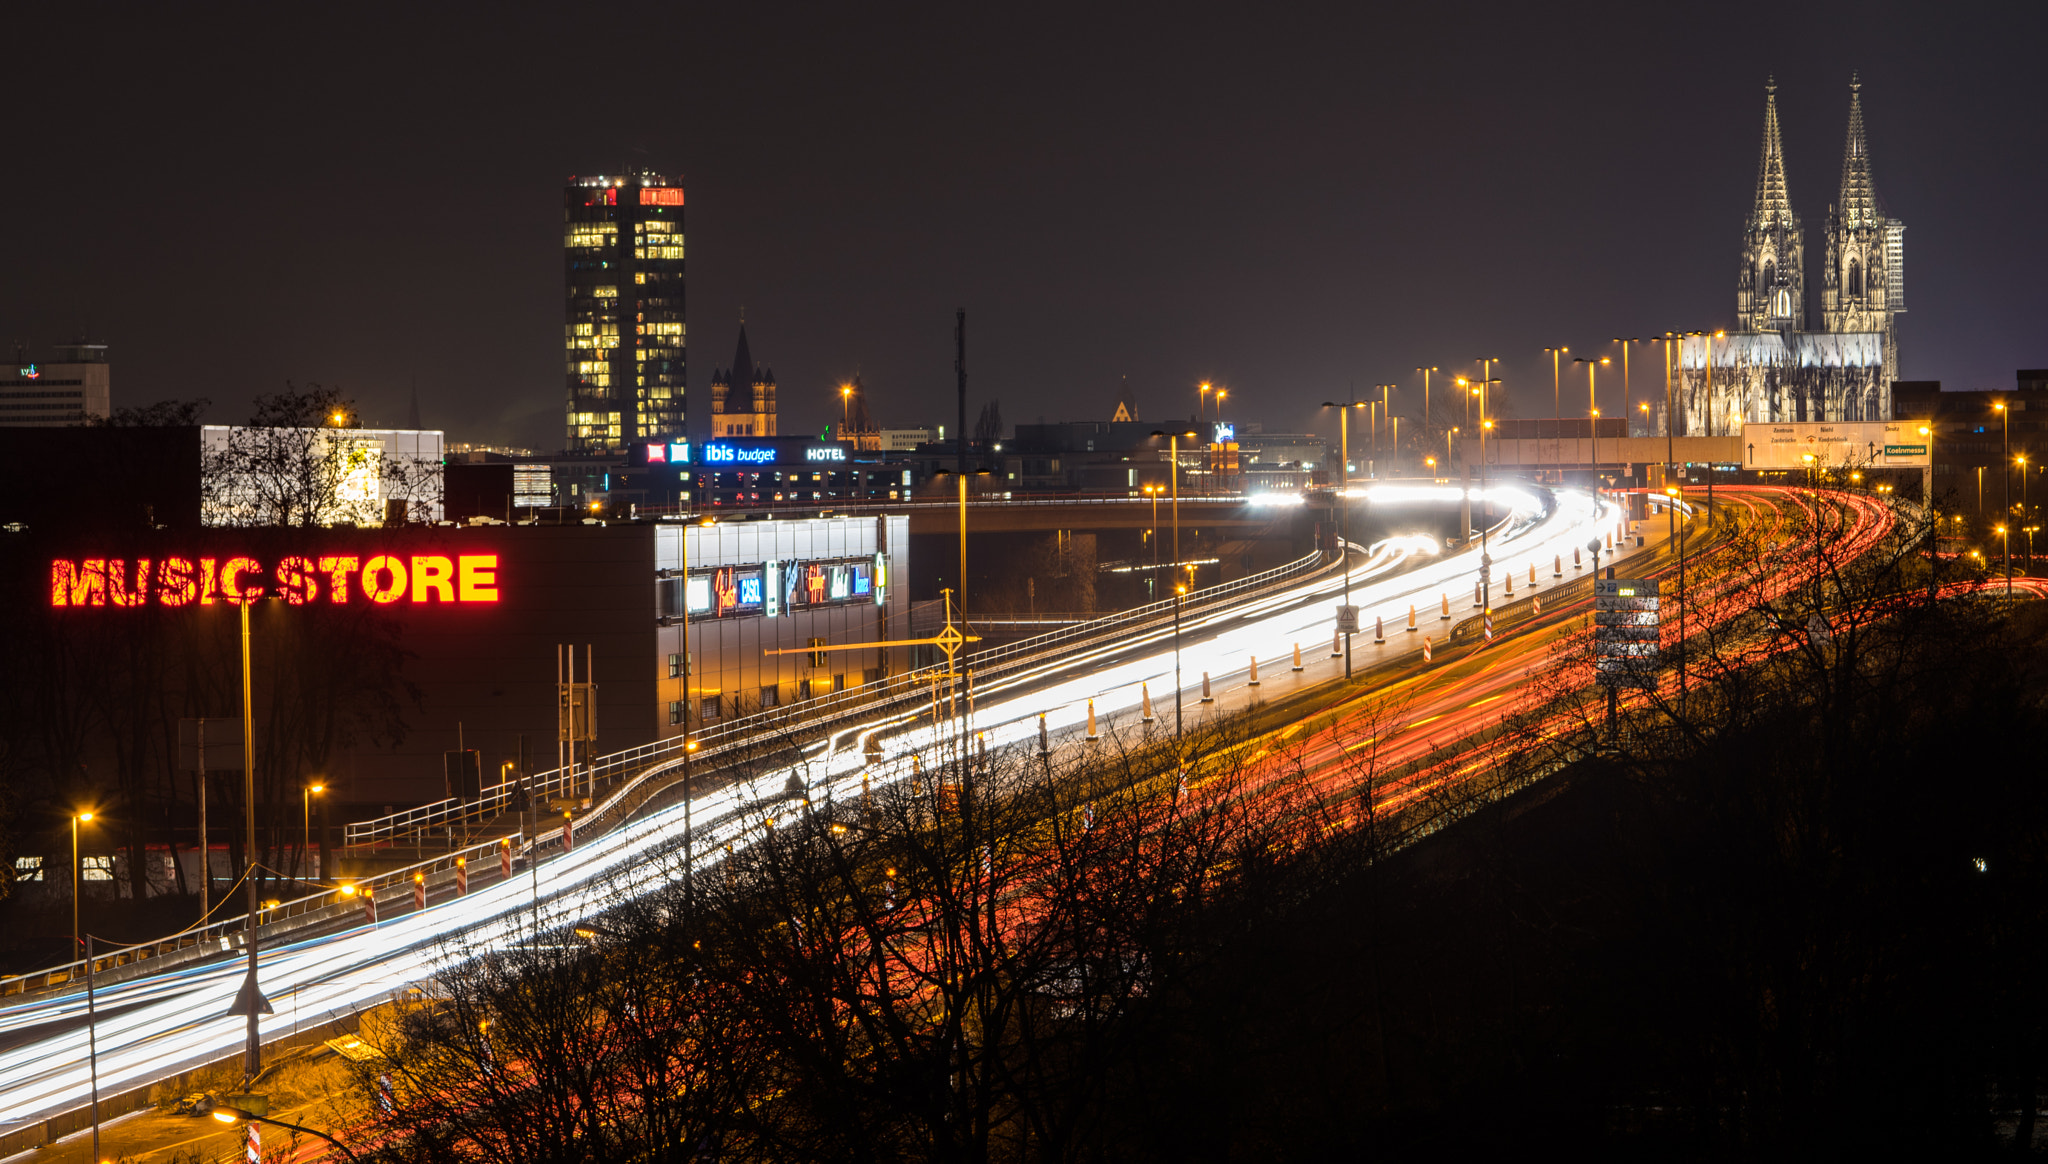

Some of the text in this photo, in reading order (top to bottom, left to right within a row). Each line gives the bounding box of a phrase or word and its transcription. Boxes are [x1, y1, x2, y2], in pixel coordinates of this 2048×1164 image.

[706, 445, 776, 464] ibis budget
[807, 448, 846, 461] HOTEL
[51, 553, 500, 607] MUSIC STORE
